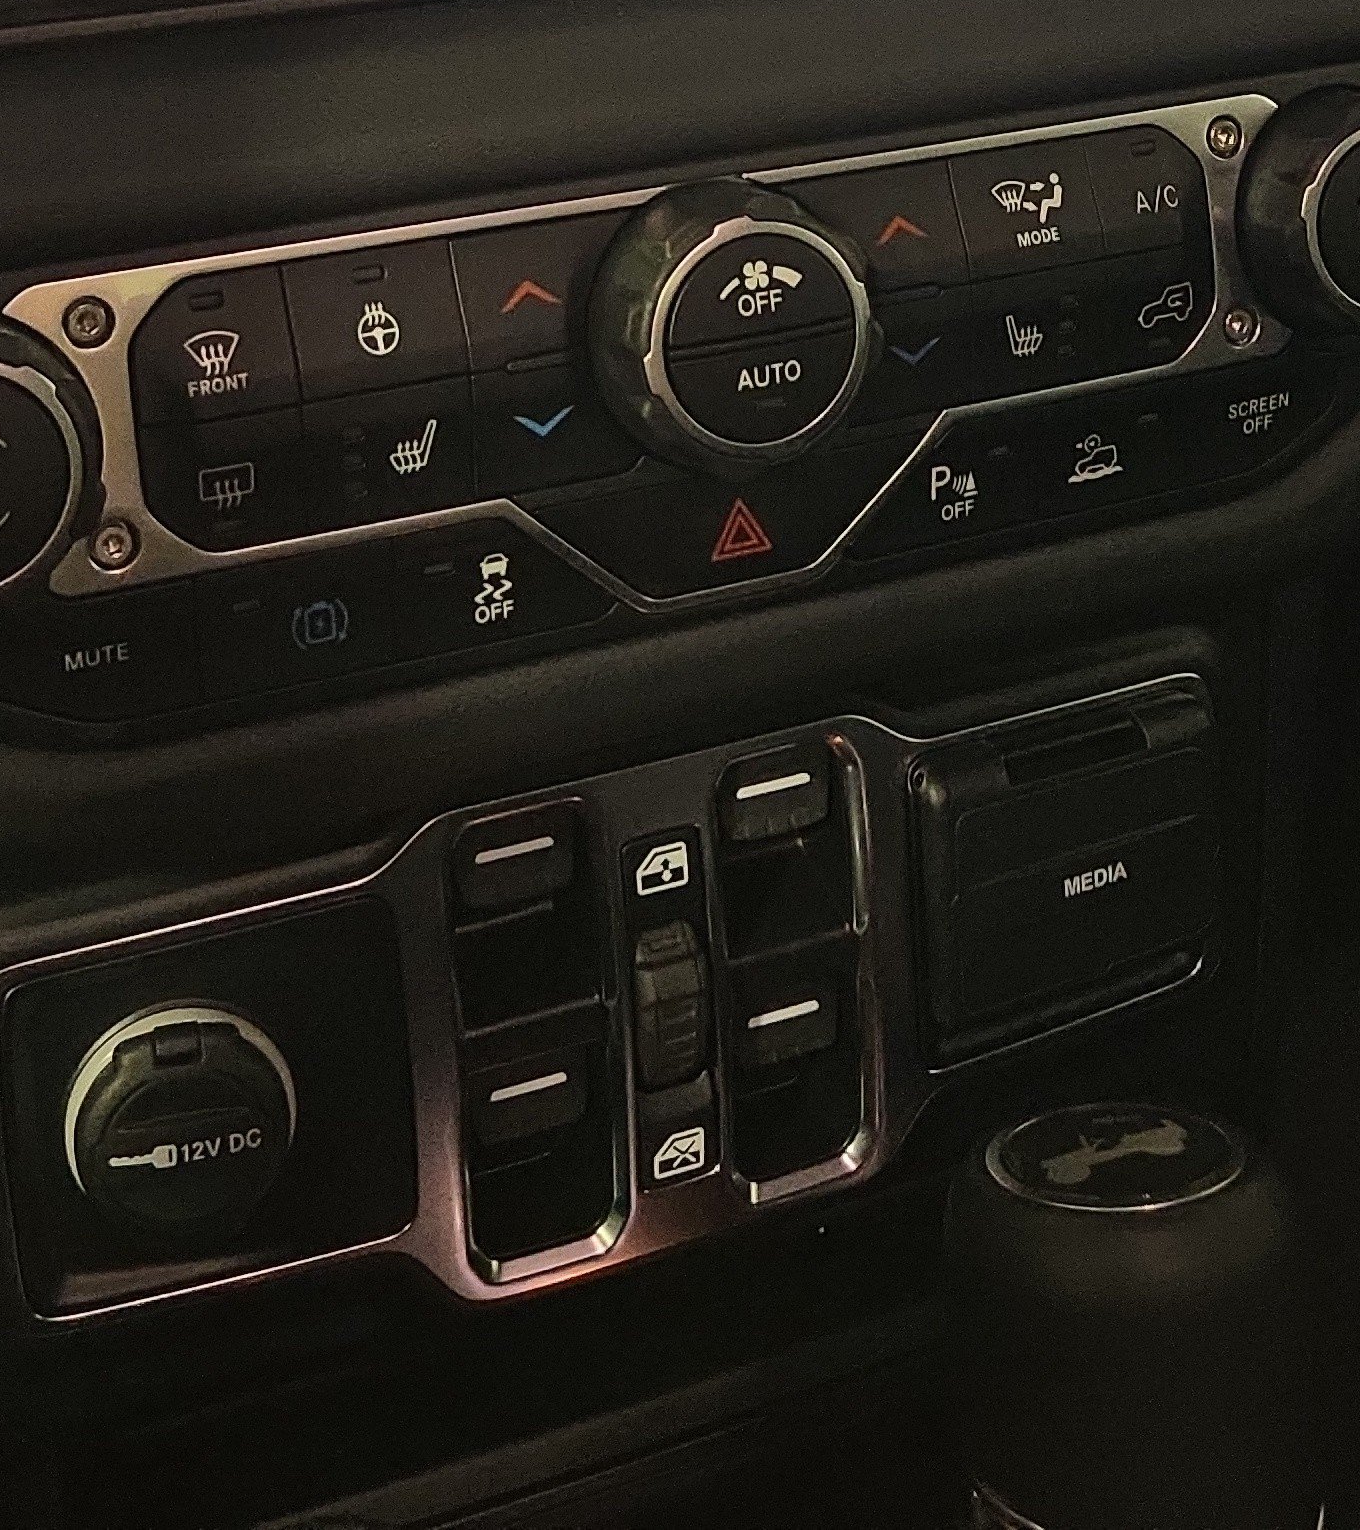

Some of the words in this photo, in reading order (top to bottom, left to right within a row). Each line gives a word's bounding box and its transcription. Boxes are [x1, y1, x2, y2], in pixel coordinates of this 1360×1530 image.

[1136, 183, 1180, 214] A/C
[1016, 226, 1061, 249] MODE
[737, 288, 784, 318] OFF
[186, 371, 250, 399] FRONT
[737, 359, 802, 391] AUTO
[1227, 391, 1290, 420] SCREEN
[1242, 412, 1274, 436] OFF
[941, 498, 975, 522] OFF
[474, 600, 515, 625] OFF
[63, 642, 131, 672] MUTE
[1063, 860, 1128, 899] MEDIA
[180, 1136, 221, 1163] 12V
[228, 1127, 263, 1154] DC
